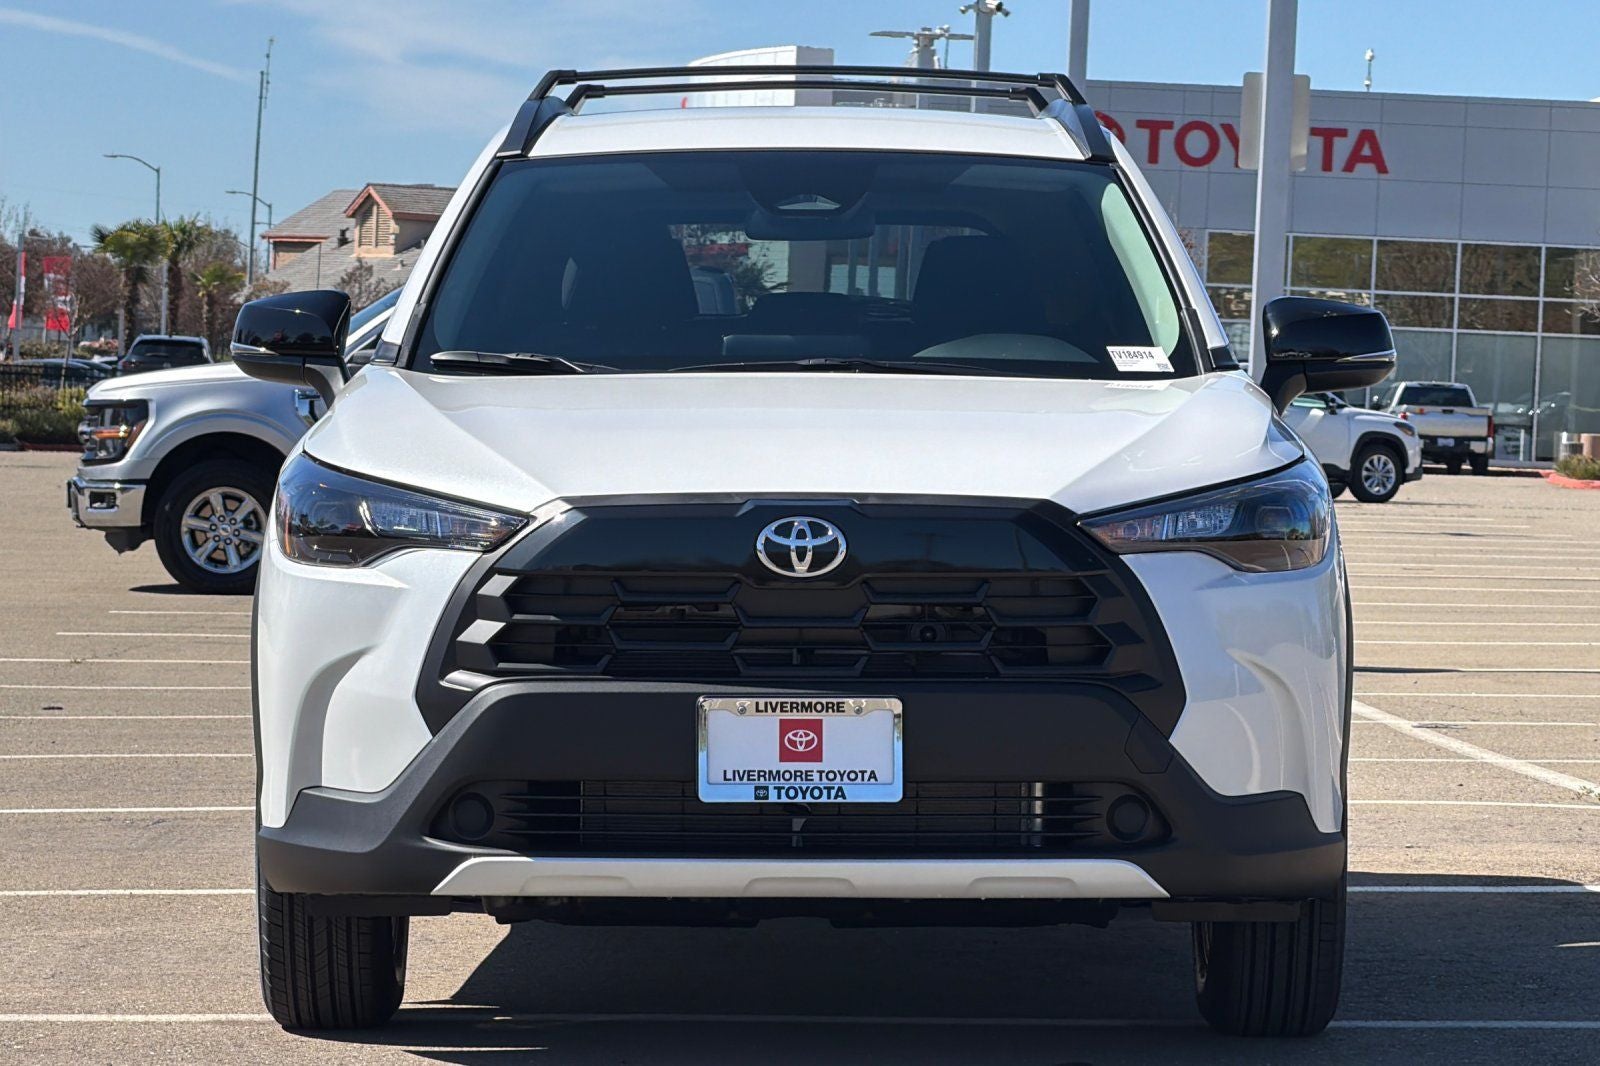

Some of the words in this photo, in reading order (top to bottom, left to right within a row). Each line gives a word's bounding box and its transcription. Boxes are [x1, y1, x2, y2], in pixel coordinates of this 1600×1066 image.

[1136, 119, 1389, 174] TOTA
[1110, 350, 1154, 359] TV184914
[755, 701, 846, 713] LIVERMORE
[723, 769, 814, 782] LIVERMORE
[819, 769, 878, 782] TOYOTA
[773, 785, 847, 800] TOYOTA
